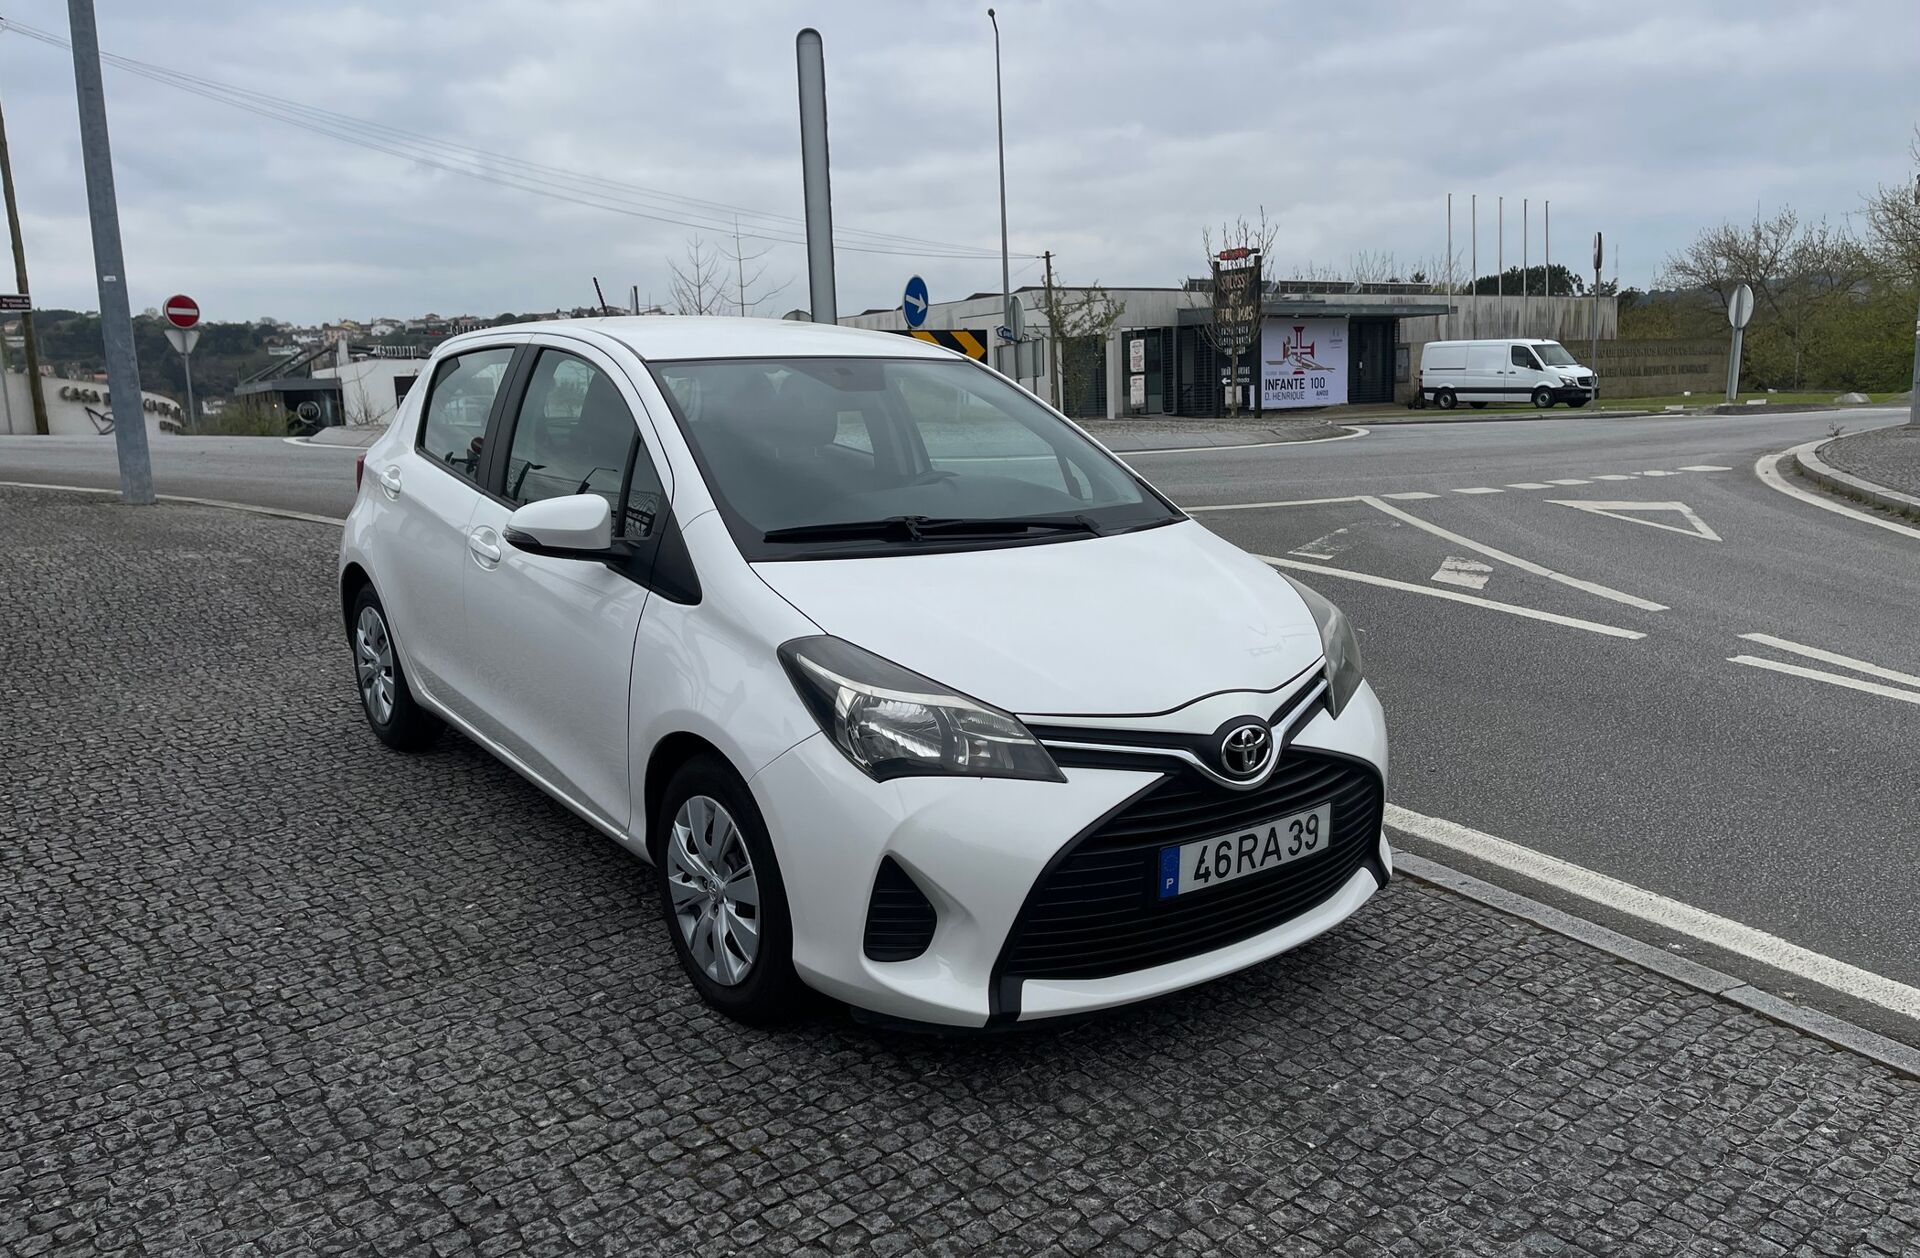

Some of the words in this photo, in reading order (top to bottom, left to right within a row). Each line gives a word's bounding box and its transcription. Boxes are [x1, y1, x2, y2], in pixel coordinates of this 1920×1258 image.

[1265, 378, 1305, 390] INFANTE
[1310, 377, 1325, 389] 100
[61, 386, 101, 403] CASA
[1272, 391, 1304, 400] HENRIQUE
[1166, 878, 1174, 889] P
